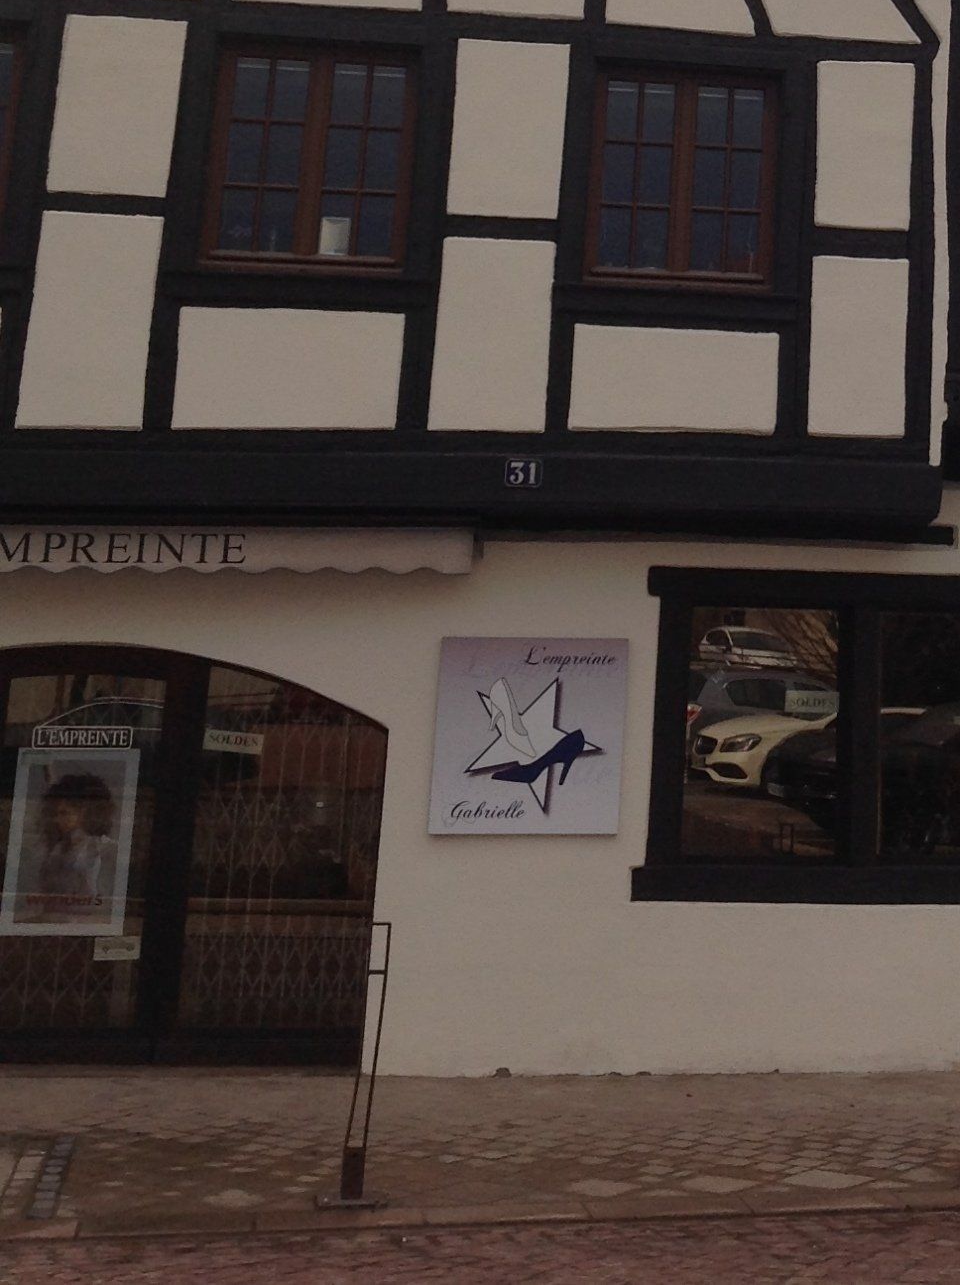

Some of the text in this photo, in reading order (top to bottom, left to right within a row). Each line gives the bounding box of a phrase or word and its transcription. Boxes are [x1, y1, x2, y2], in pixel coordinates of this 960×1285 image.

[509, 461, 537, 484] 31
[519, 645, 617, 672] L'empreinte
[37, 728, 129, 746] L'EMPREINTE
[450, 800, 525, 819] Gabrielle
